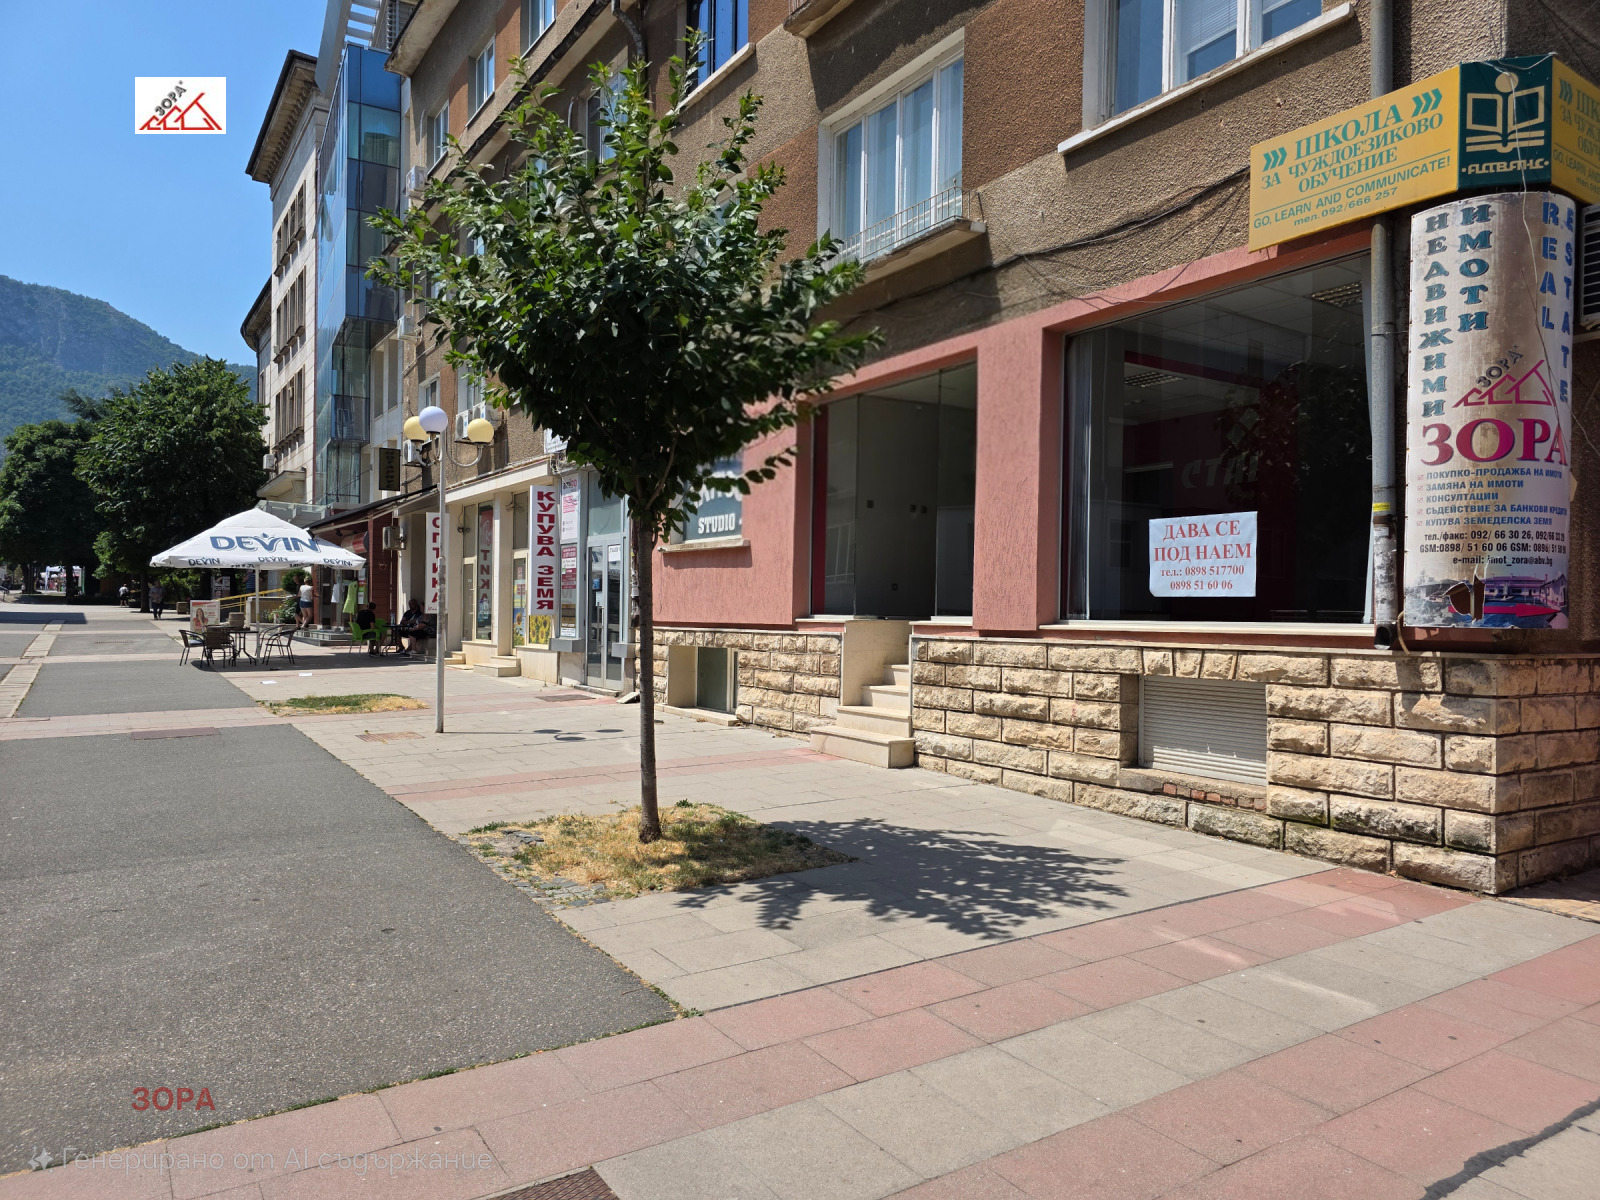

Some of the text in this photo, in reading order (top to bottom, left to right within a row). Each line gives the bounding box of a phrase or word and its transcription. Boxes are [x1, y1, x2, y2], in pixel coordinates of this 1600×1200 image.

[1295, 104, 1403, 161] ШКОЛА
[1261, 113, 1443, 190] ЗА ЧУЖДОЕЗИКОВО
[1299, 147, 1398, 193] ОБУЧЕНИЕ
[1253, 156, 1450, 229] GO, LEARN AND COMMUNICATE!
[1374, 187, 1398, 201] 257
[1457, 204, 1492, 332] ИМОТИ
[1540, 201, 1559, 330] REAL
[1418, 212, 1453, 418] НЕДВИЖИМИ
[1560, 207, 1574, 403] ESTATE
[1476, 349, 1524, 388] ЗОРА
[1420, 417, 1568, 466] ЗОРА
[1426, 467, 1531, 480] ПОКУПКО-ПРОДАЖБА
[1534, 468, 1544, 477] НА
[1426, 480, 1524, 491] ЗАМЯНА НА ИМОТИ
[1426, 492, 1499, 503] КОНСУЛТАЦИИ
[1494, 504, 1507, 512] ЗА
[1510, 504, 1548, 513] БАНКОВИ
[536, 491, 556, 556] КУПУВА
[698, 512, 736, 534] STUDIO
[1162, 520, 1241, 542] ДАВА СЕ
[1425, 516, 1552, 527] КУПУВА ЗЕМЕДЕЛСКА ЗЕМЯ
[210, 536, 321, 553] DEVIN
[1424, 531, 1467, 542] тел./факс:
[1471, 530, 1492, 540] 092/
[1494, 530, 1506, 539] 66
[1508, 530, 1519, 539] 30
[1521, 530, 1534, 540] 26,
[1154, 543, 1252, 563] ПОД НАЕМ
[1467, 543, 1478, 552] 51
[1482, 542, 1493, 552] 60
[1496, 542, 1507, 552] 06
[1510, 542, 1531, 552] GSM:
[188, 557, 220, 566] DEVIN
[1453, 555, 1484, 565] e-mail:
[1161, 565, 1245, 577] тел.: 0898 517700
[536, 565, 554, 610] ЗЕМЯ
[1170, 580, 1233, 591] 0898 51 60 06
